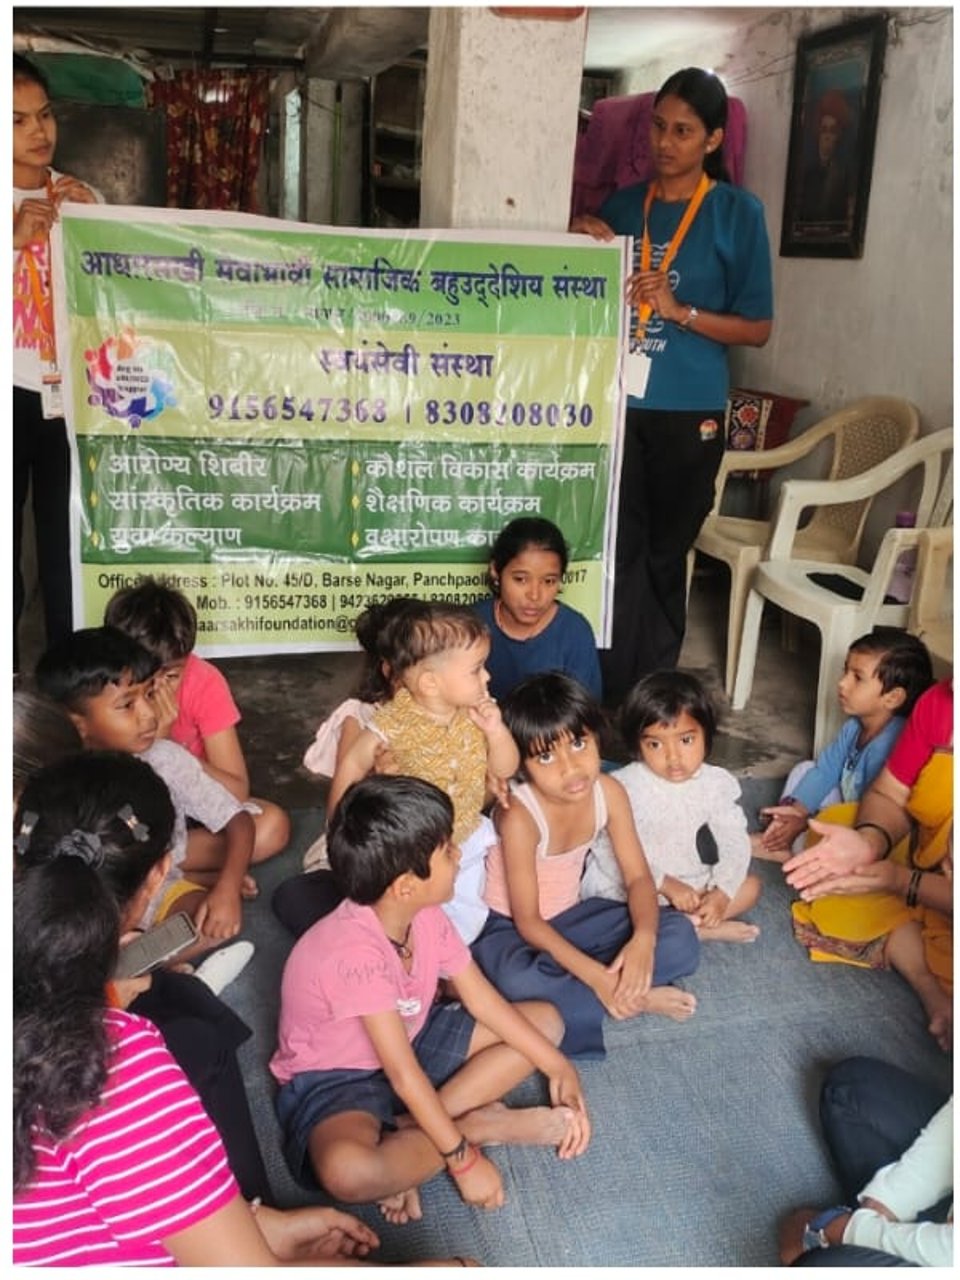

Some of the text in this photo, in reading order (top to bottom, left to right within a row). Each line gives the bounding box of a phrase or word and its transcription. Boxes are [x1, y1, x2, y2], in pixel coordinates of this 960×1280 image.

[323, 257, 422, 293] सामाजिक
[553, 264, 607, 300] संस्था
[431, 342, 494, 378] संस्था
[109, 450, 268, 477] आरोग्य शिबीर
[516, 455, 596, 483] कार्यक्रम
[108, 486, 322, 518] सांस्कृतिक कार्यक्रम
[365, 487, 542, 515] शैक्षणिक कार्यक्रम
[158, 527, 242, 547] कल्याण
[221, 572, 250, 588] Plot
[254, 573, 279, 588] No.
[322, 572, 362, 588] Barse
[365, 572, 409, 590] Nagar,
[244, 595, 328, 610] 9156547368
